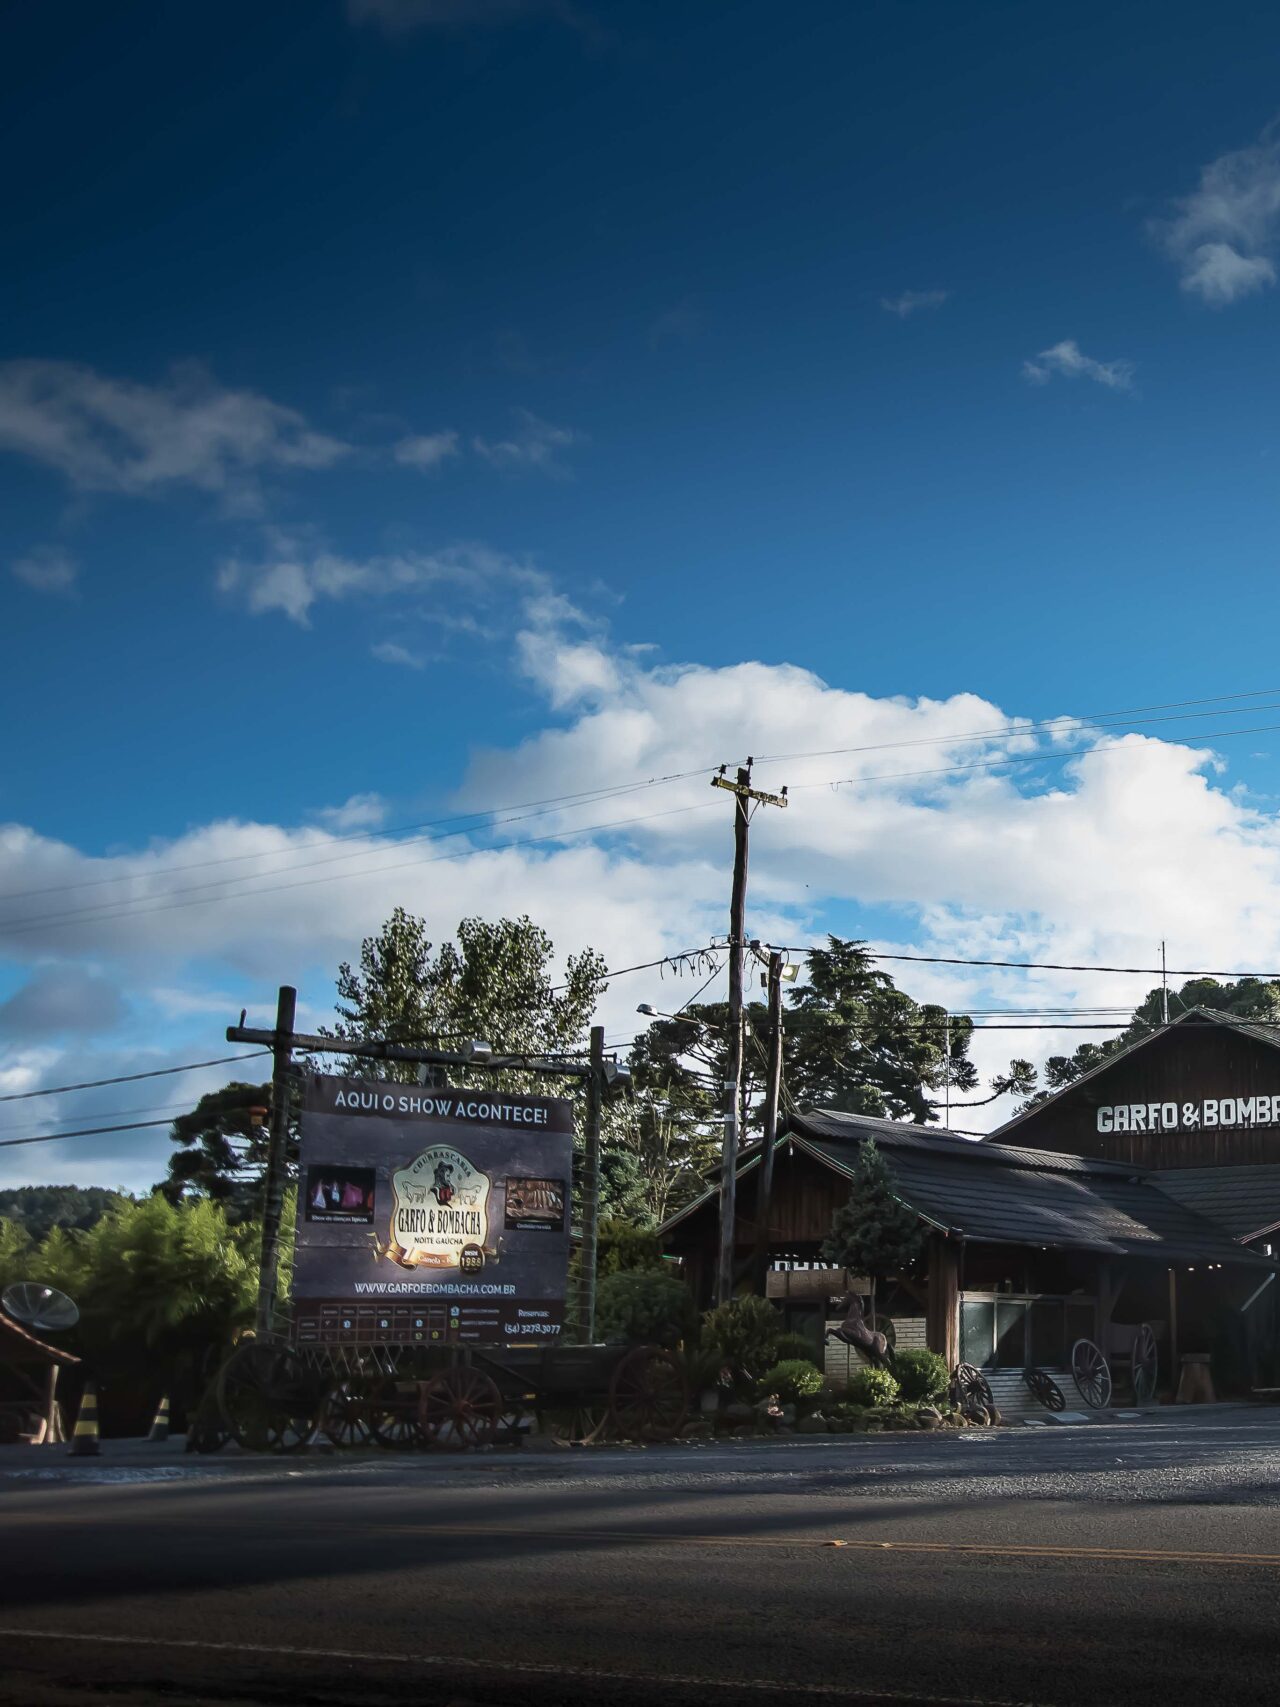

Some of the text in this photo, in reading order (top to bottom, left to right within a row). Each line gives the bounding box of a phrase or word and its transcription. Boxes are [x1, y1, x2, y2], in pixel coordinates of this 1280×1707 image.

[335, 1090, 548, 1124] AQUI O SHOW ACONTECE!
[1096, 1102, 1178, 1132] GARFO
[1182, 1102, 1200, 1126] &
[412, 1151, 471, 1177] CHURRASCARIA
[398, 1208, 481, 1235] GARFO & BOMBACHA
[414, 1236, 434, 1245] NOITE
[355, 1282, 516, 1295] WWW.GARFOEBOMBACHA.COM.BR
[504, 1322, 520, 1334] (54)
